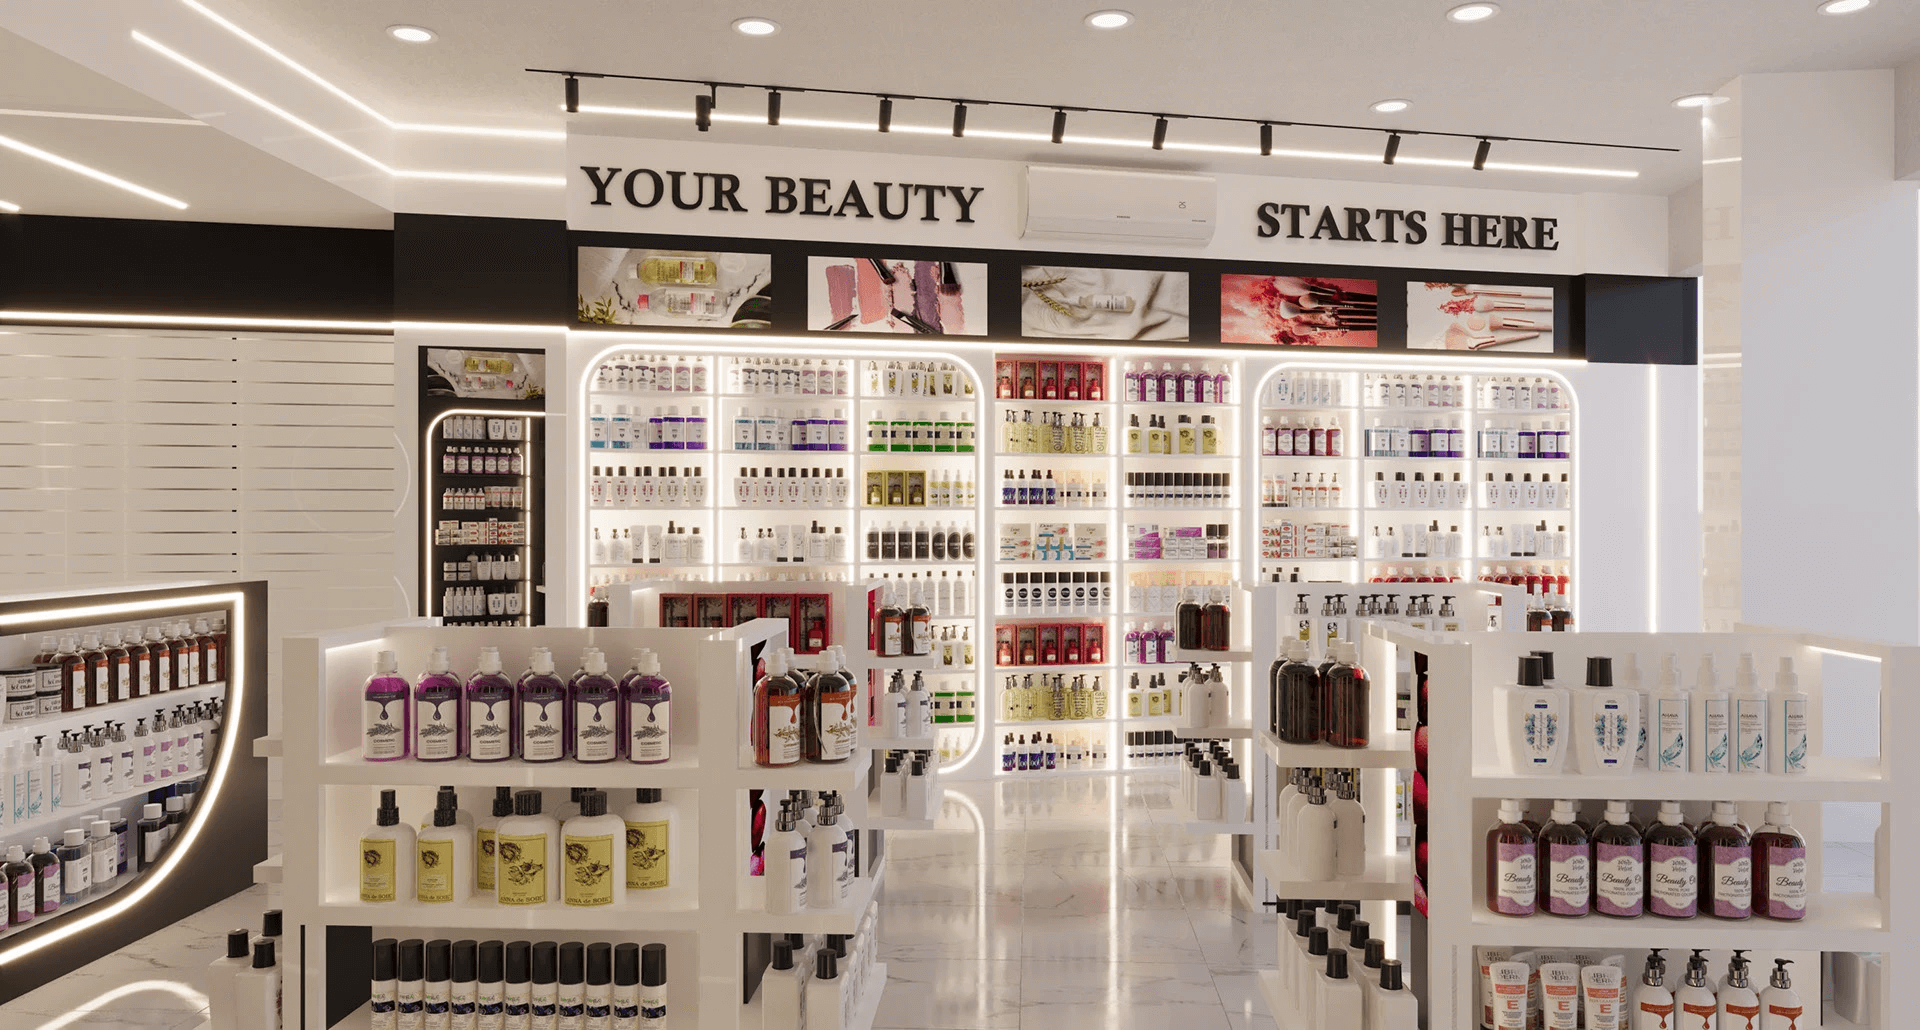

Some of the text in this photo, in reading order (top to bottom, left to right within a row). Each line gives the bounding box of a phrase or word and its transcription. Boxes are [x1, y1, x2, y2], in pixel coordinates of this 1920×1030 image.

[580, 166, 984, 223] YOUR BEAUTY
[1257, 202, 1560, 251] STARTS HERE
[1504, 873, 1531, 884] Beauty
[1556, 873, 1584, 886] Beauty
[1602, 873, 1632, 886] Beauty
[1656, 873, 1686, 887] Beauty
[1721, 876, 1748, 888] Beauty
[1776, 877, 1803, 889] Beauty
[1507, 1000, 1519, 1010] E
[1558, 1001, 1570, 1010] E
[1600, 1004, 1611, 1013] E
